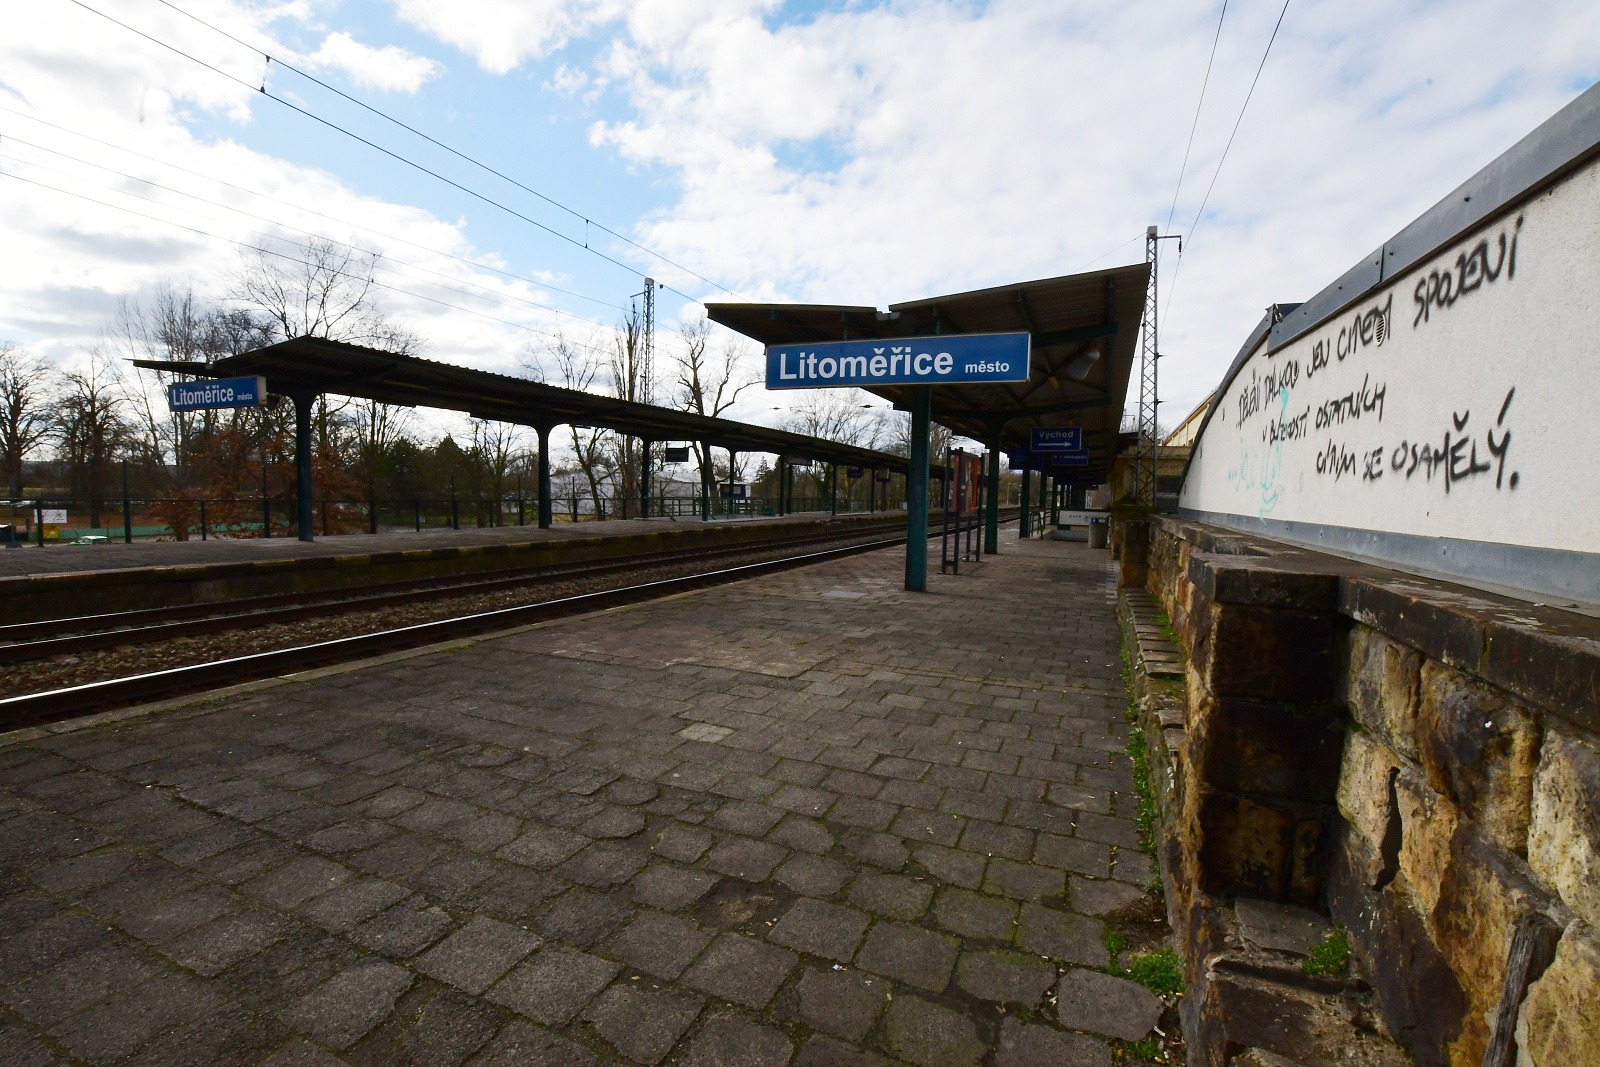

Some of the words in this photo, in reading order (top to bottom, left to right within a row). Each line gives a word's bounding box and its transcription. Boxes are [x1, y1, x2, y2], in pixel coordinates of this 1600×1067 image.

[779, 346, 954, 380] Litoměřice
[964, 361, 1010, 374] město
[1307, 338, 1330, 378] JEN
[173, 384, 234, 406] Litoměřice
[1315, 373, 1386, 430] OSTATNÍCH
[1039, 430, 1074, 440] Východ
[1363, 445, 1383, 481] SE
[1391, 385, 1519, 494] OSAMĚLÝ.
